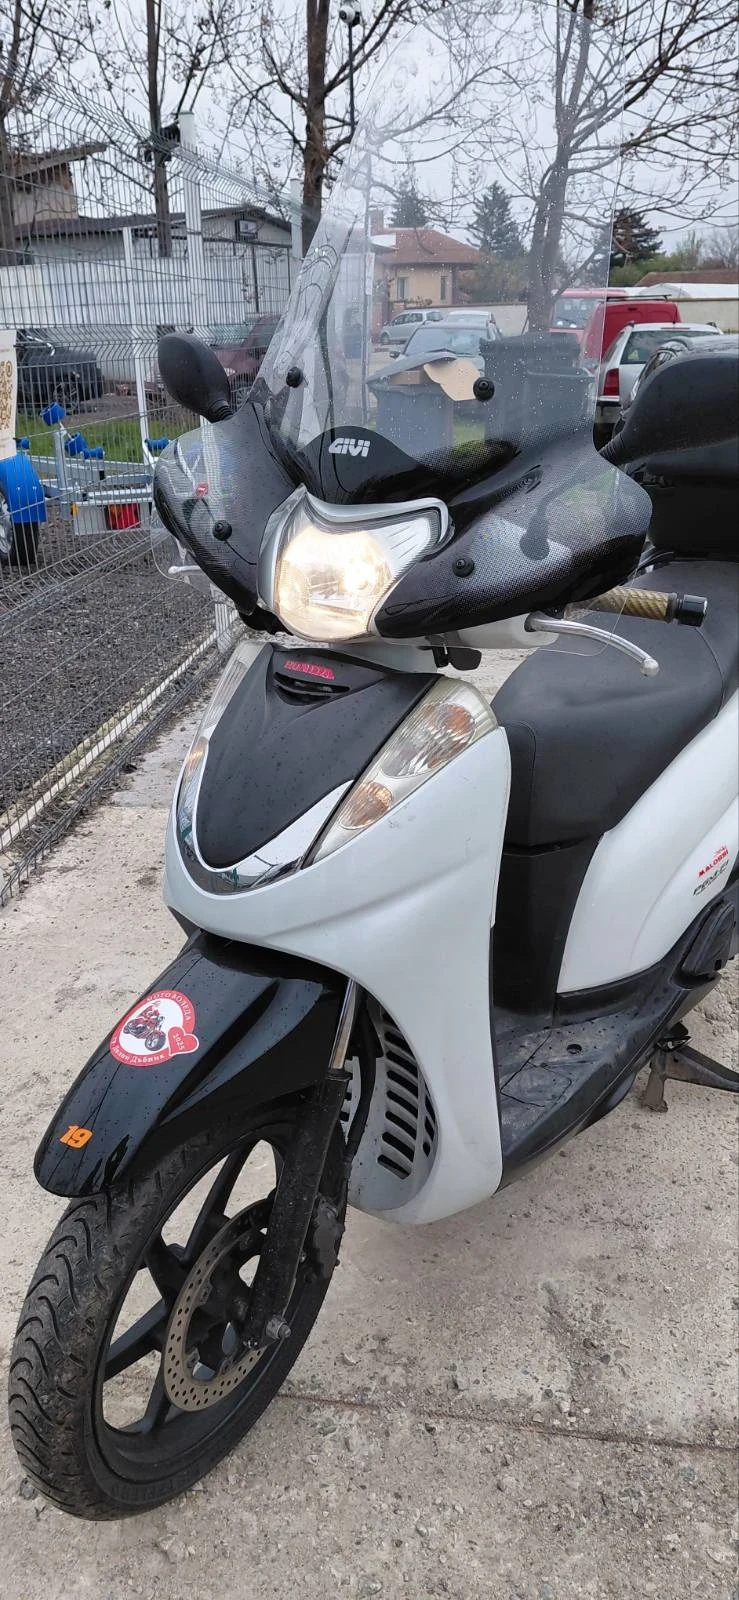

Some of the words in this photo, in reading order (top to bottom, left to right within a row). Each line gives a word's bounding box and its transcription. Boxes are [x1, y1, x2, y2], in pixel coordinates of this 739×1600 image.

[329, 438, 370, 457] GIVI
[284, 660, 334, 680] HONDA
[699, 849, 729, 878] MALOSSI
[60, 1125, 93, 1148] 19
